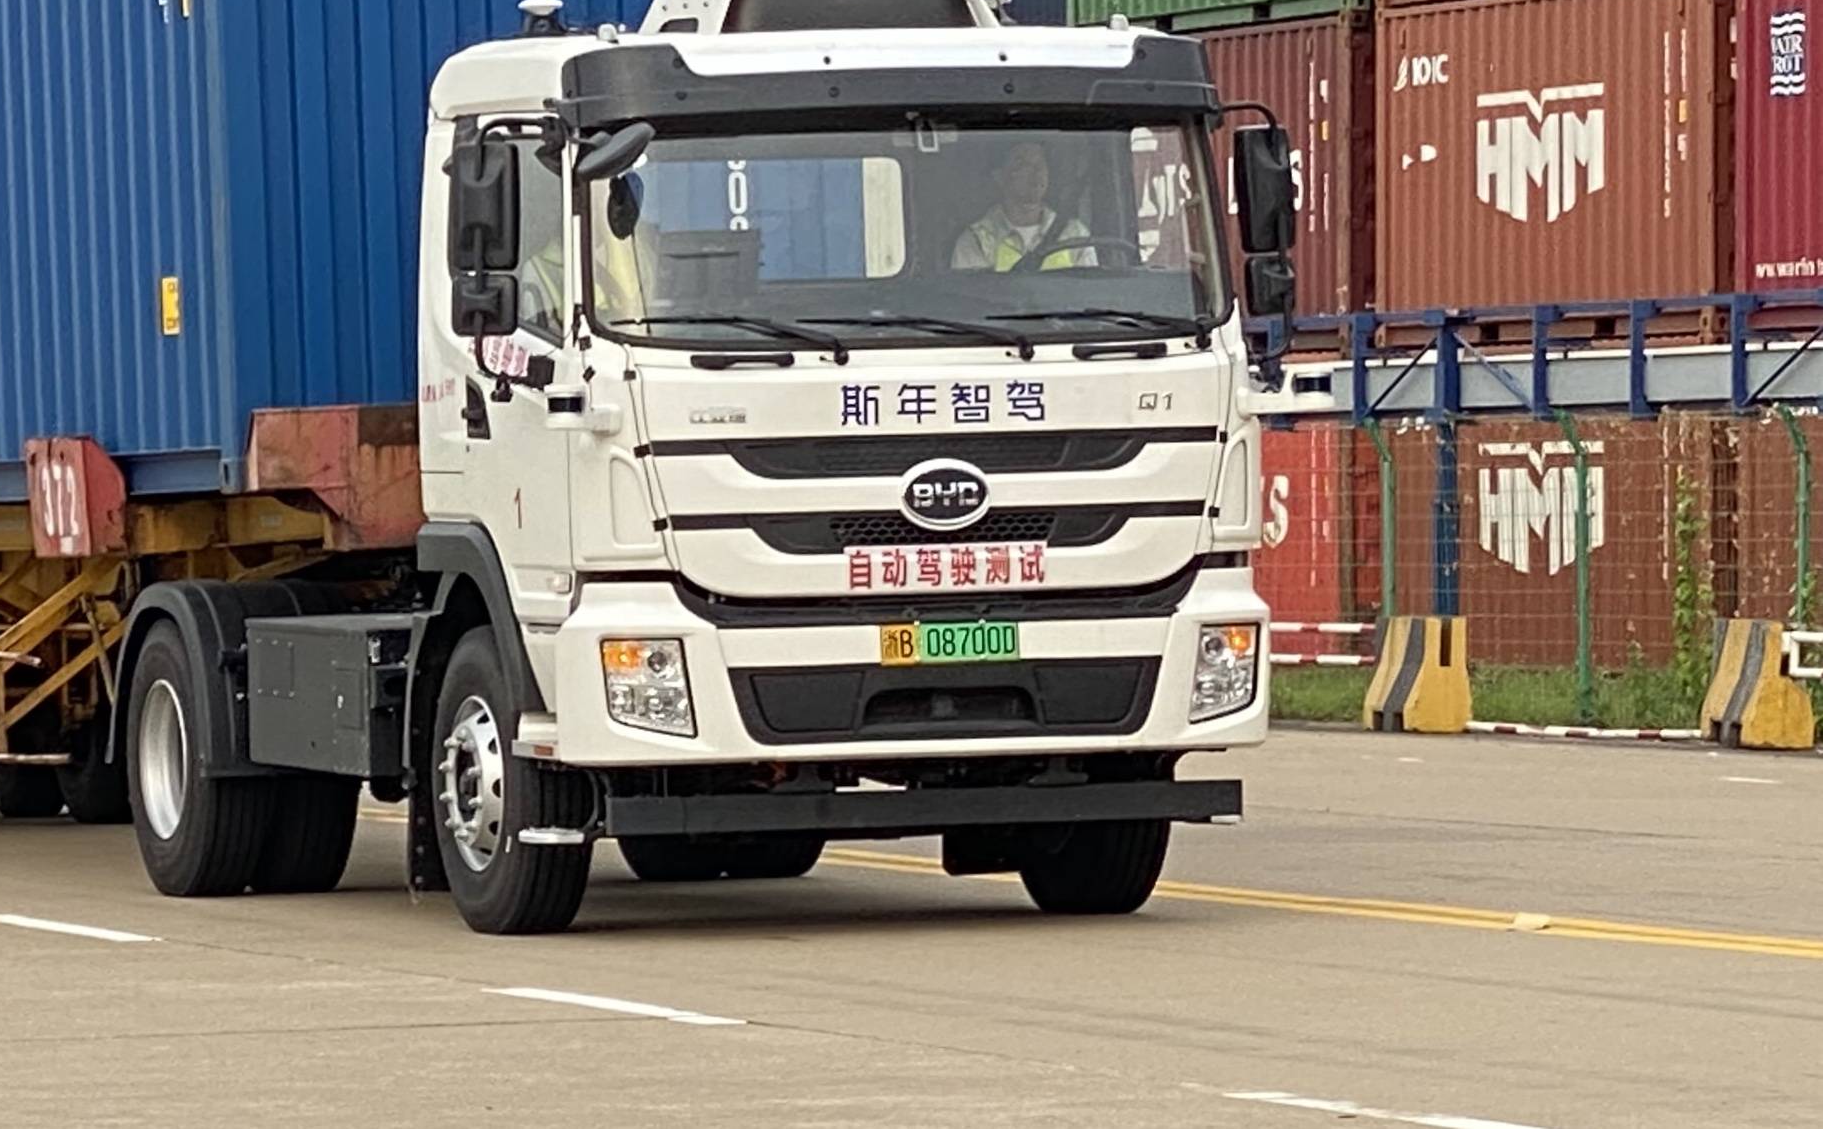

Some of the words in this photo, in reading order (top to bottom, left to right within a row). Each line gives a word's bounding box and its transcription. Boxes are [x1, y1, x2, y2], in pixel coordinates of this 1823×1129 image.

[1477, 82, 1605, 223] HMM
[840, 380, 1046, 426] 斯年智驾
[912, 481, 980, 508] BYD
[848, 544, 1047, 591] 自动驾驶测试
